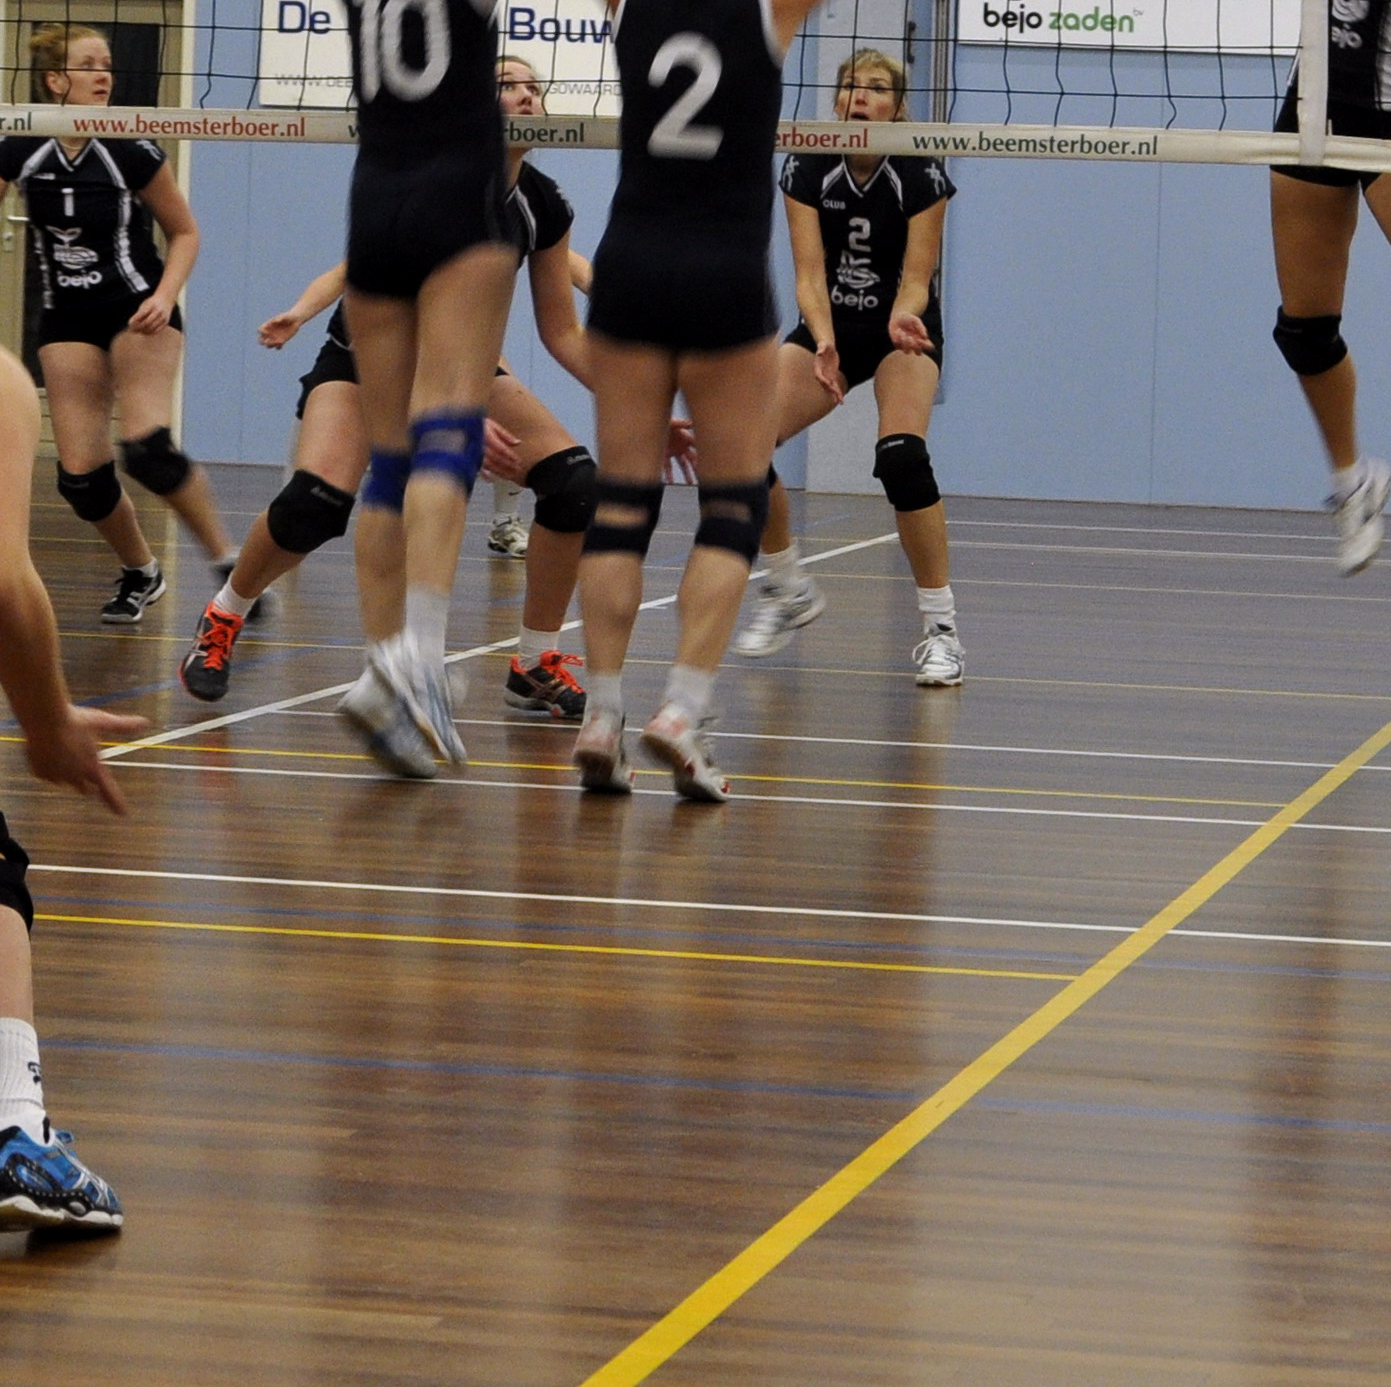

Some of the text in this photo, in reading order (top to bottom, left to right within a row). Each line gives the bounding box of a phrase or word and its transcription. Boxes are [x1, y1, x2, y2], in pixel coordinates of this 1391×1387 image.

[277, 0, 331, 34] De
[983, 3, 1134, 33] bejo zaden
[647, 31, 725, 160] 2
[73, 115, 306, 138] www.beemsterboer.nl
[913, 131, 1158, 156] www.beemsterboer.nl
[847, 217, 871, 252] 2
[830, 286, 878, 312] bejo
